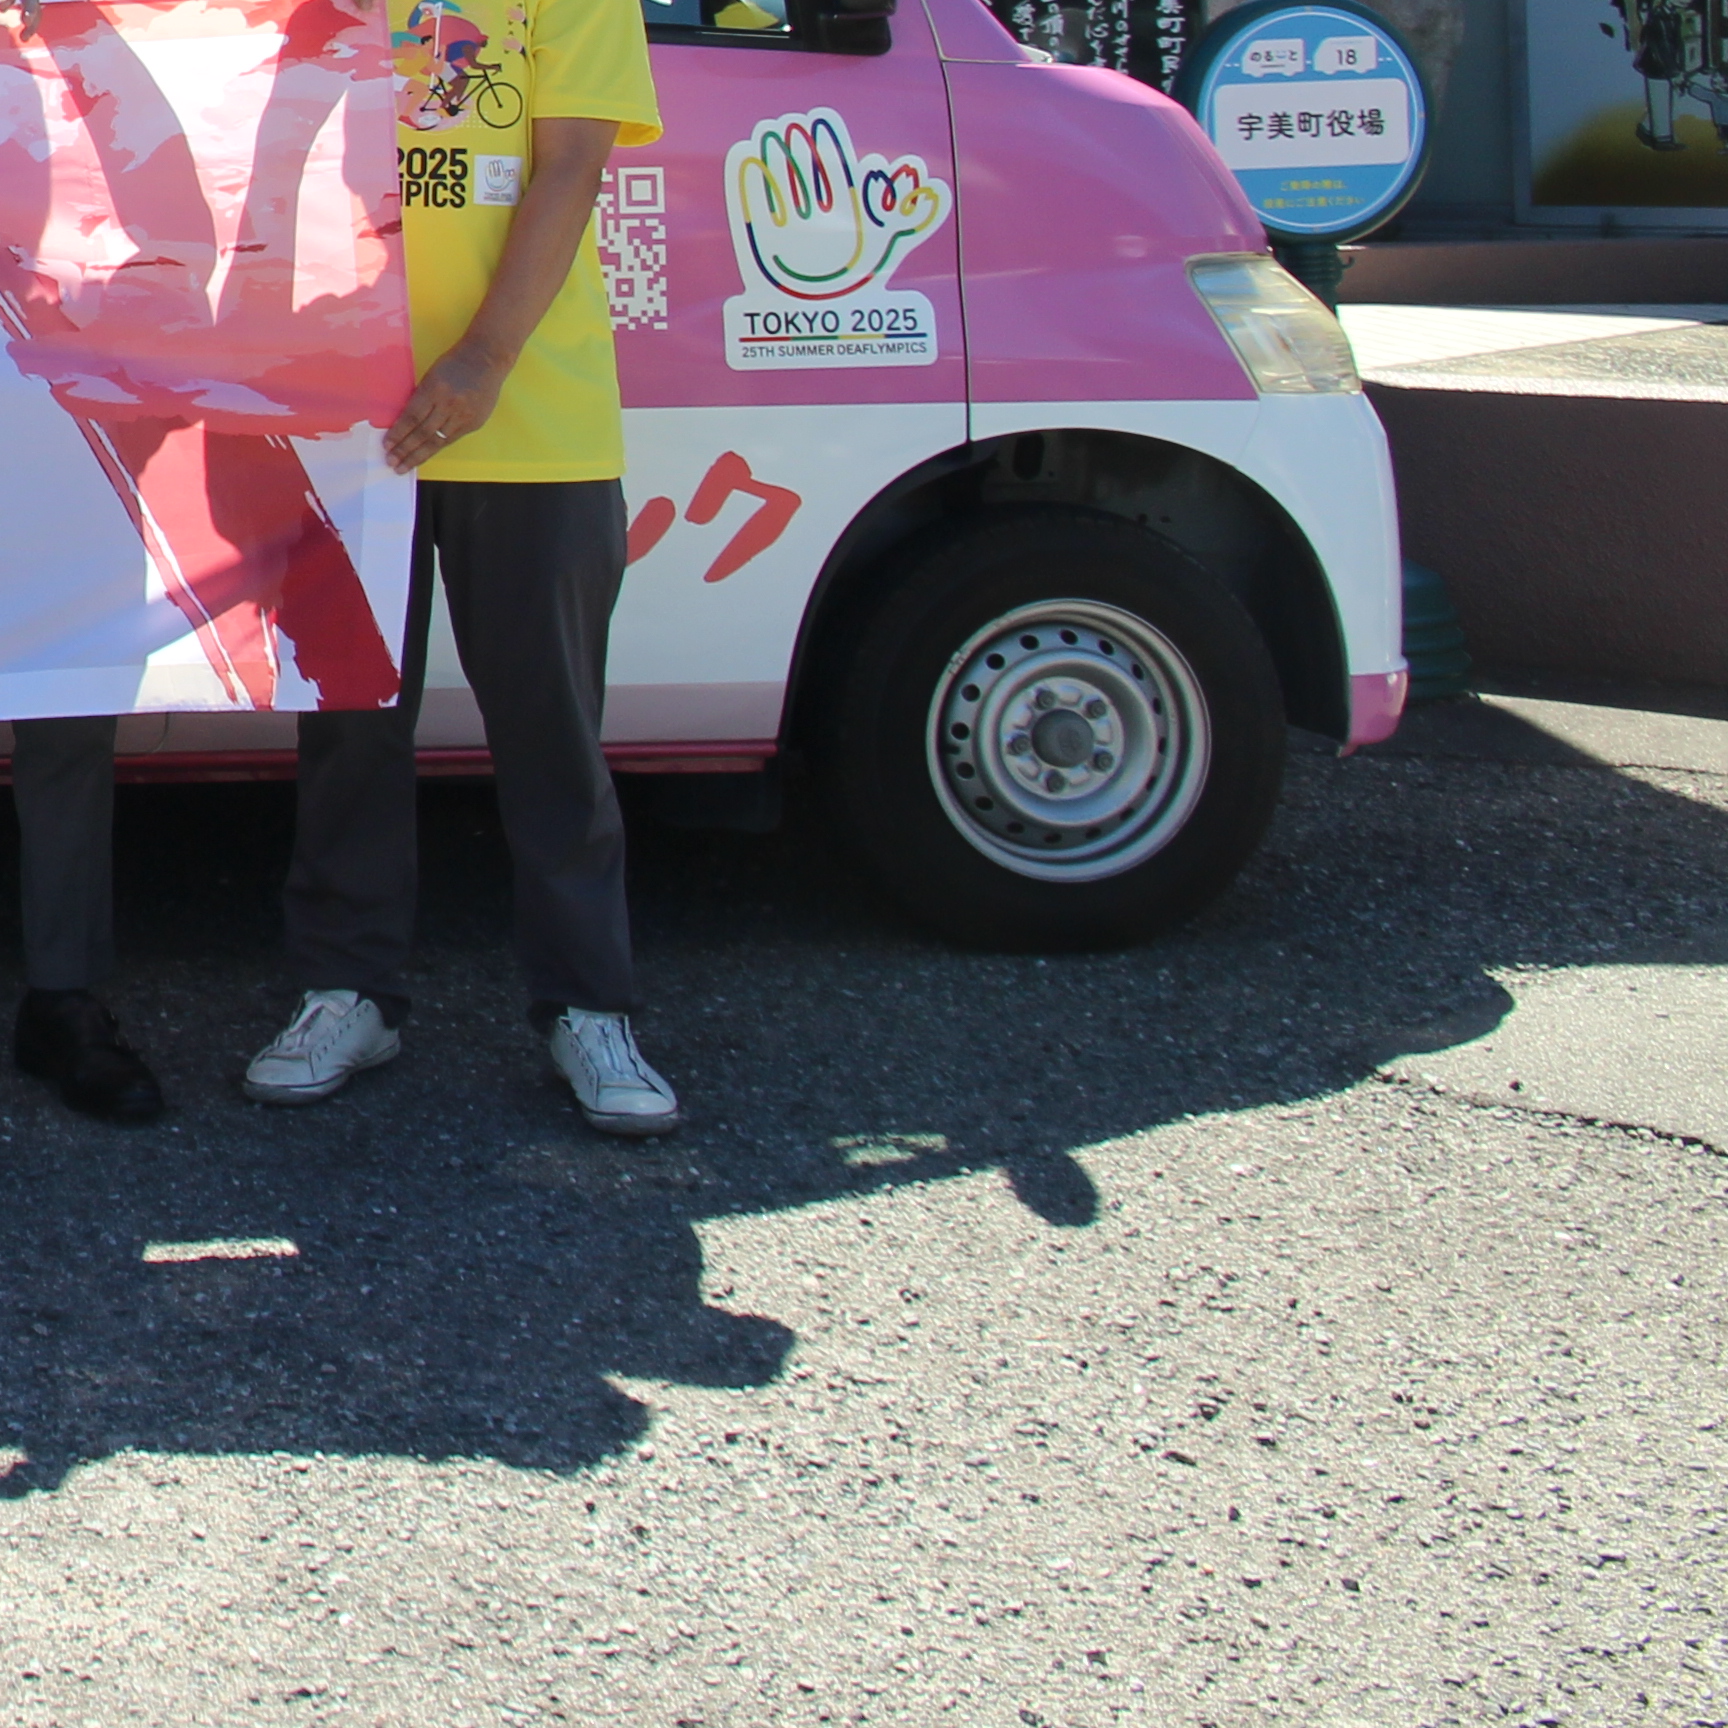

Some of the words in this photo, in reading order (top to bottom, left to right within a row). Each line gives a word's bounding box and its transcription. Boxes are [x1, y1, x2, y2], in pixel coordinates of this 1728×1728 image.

[1337, 49, 1357, 65] 18
[1237, 108, 1385, 141] 宇美町役場
[399, 180, 466, 208] PICS
[743, 310, 840, 335] TOKYO
[851, 308, 918, 332] 2025
[742, 345, 775, 358] 25TH
[778, 343, 835, 357] SUMMER
[837, 341, 927, 356] DEAFLYMPICS
